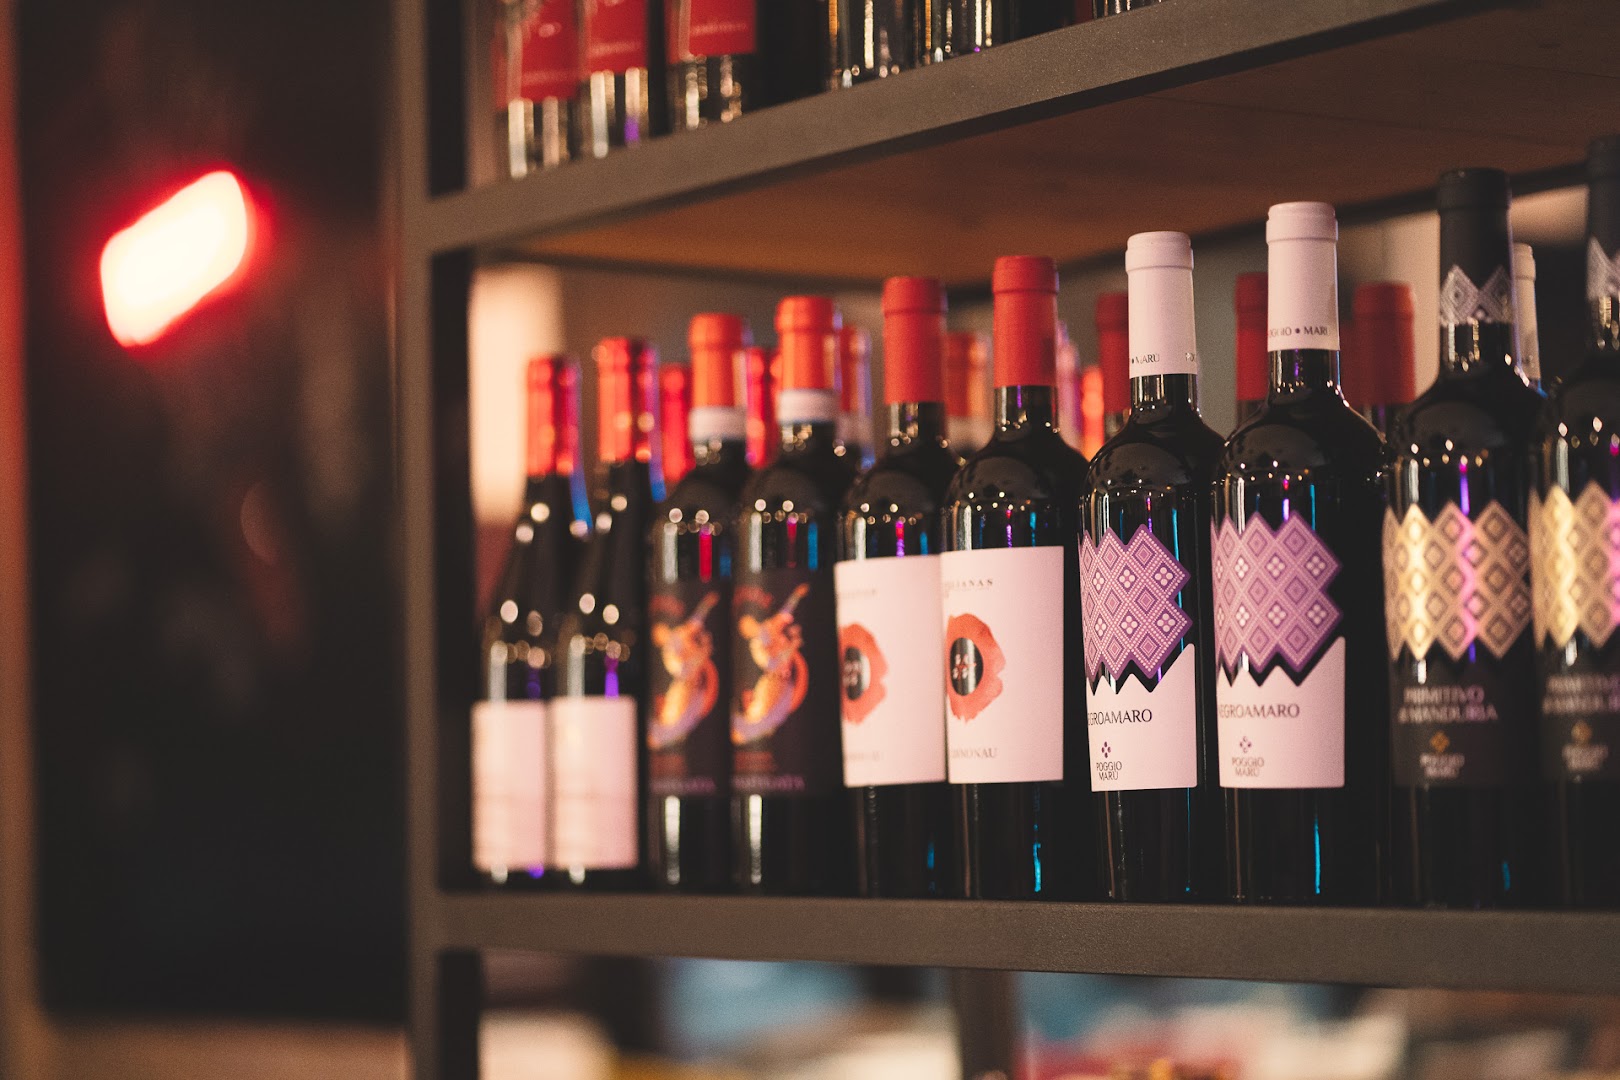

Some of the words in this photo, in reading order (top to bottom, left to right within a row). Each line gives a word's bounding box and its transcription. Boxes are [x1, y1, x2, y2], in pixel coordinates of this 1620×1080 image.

[1088, 708, 1153, 726] EGROAMARO
[1218, 703, 1300, 719] EGROAMARO
[1096, 761, 1122, 772] POGGIO
[1231, 757, 1265, 768] POGGIO
